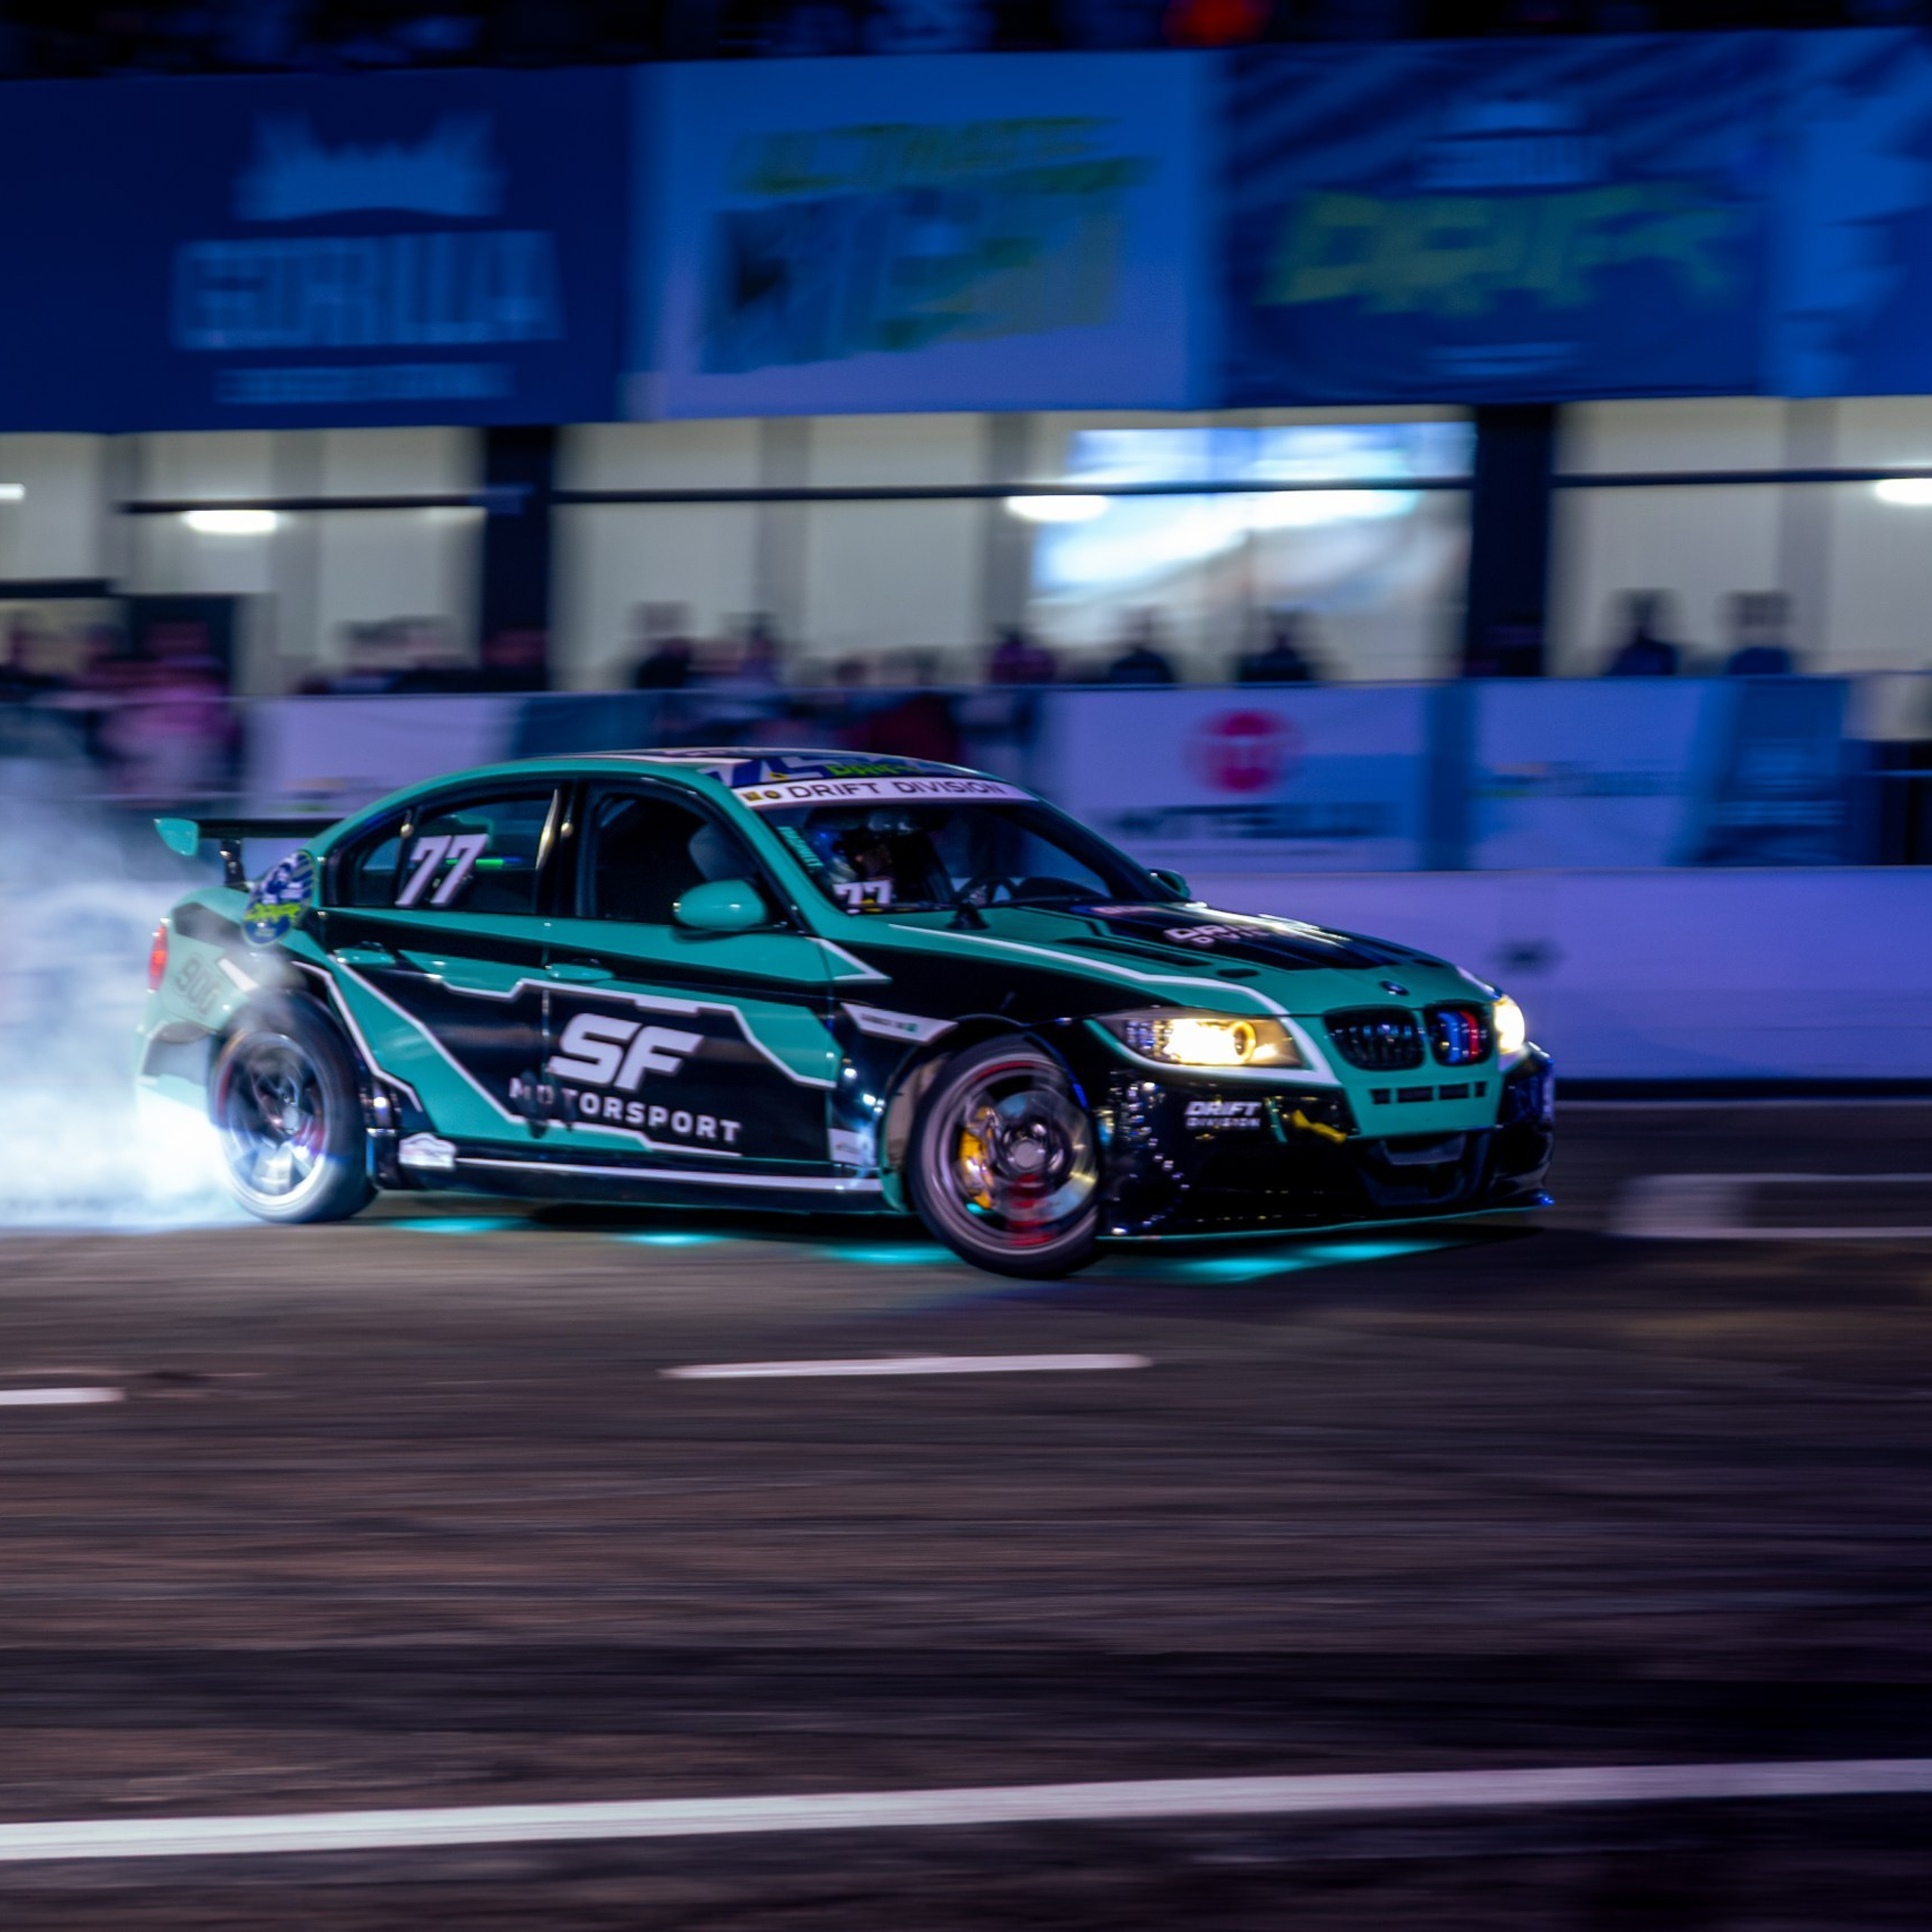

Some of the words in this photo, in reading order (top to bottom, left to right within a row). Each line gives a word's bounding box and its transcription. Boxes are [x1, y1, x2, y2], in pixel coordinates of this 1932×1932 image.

[786, 782, 881, 799] DRIFT
[892, 780, 1008, 795] DIVISION
[394, 833, 490, 906] 77
[831, 878, 894, 905] 77
[549, 1012, 705, 1093] SF
[1184, 1100, 1263, 1116] DRIFT
